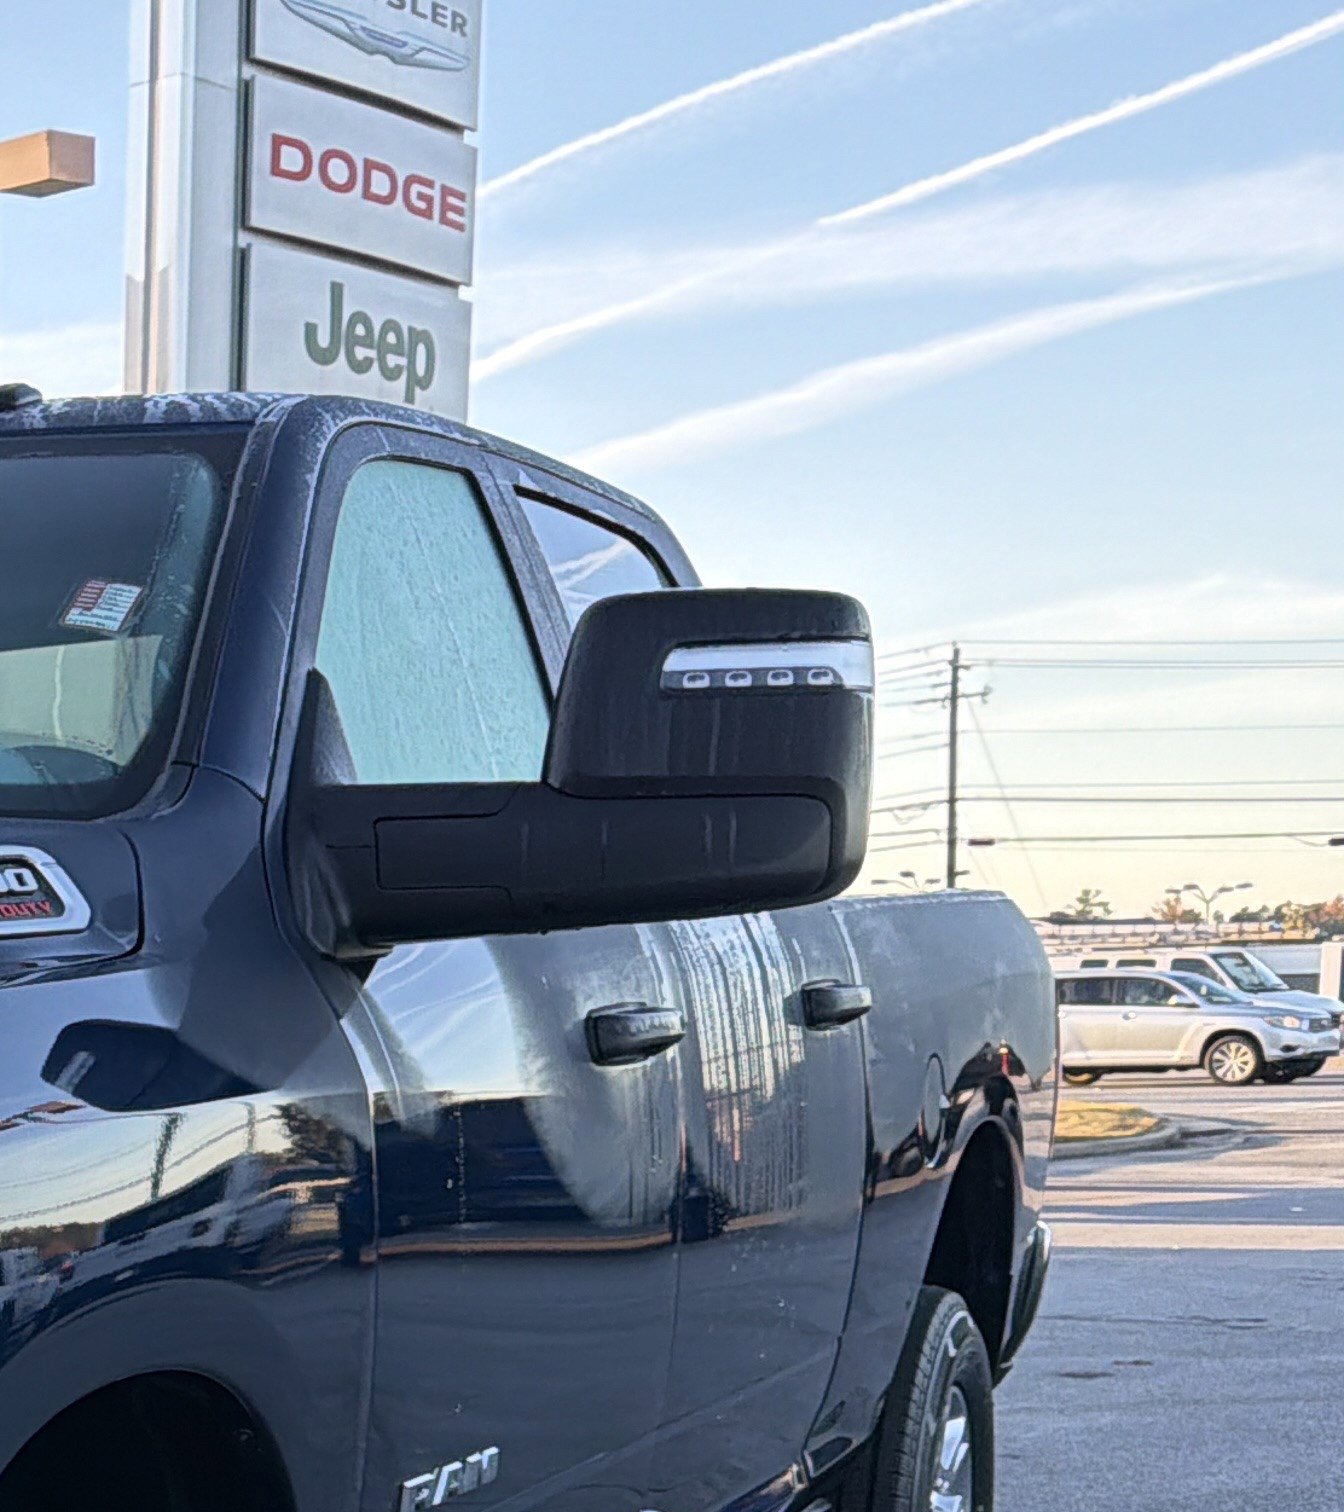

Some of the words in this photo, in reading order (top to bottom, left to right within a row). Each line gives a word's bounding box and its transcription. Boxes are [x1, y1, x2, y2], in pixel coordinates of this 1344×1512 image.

[269, 132, 467, 233] DODGE
[303, 279, 436, 405] Jeep
[0, 901, 52, 917] DUTY
